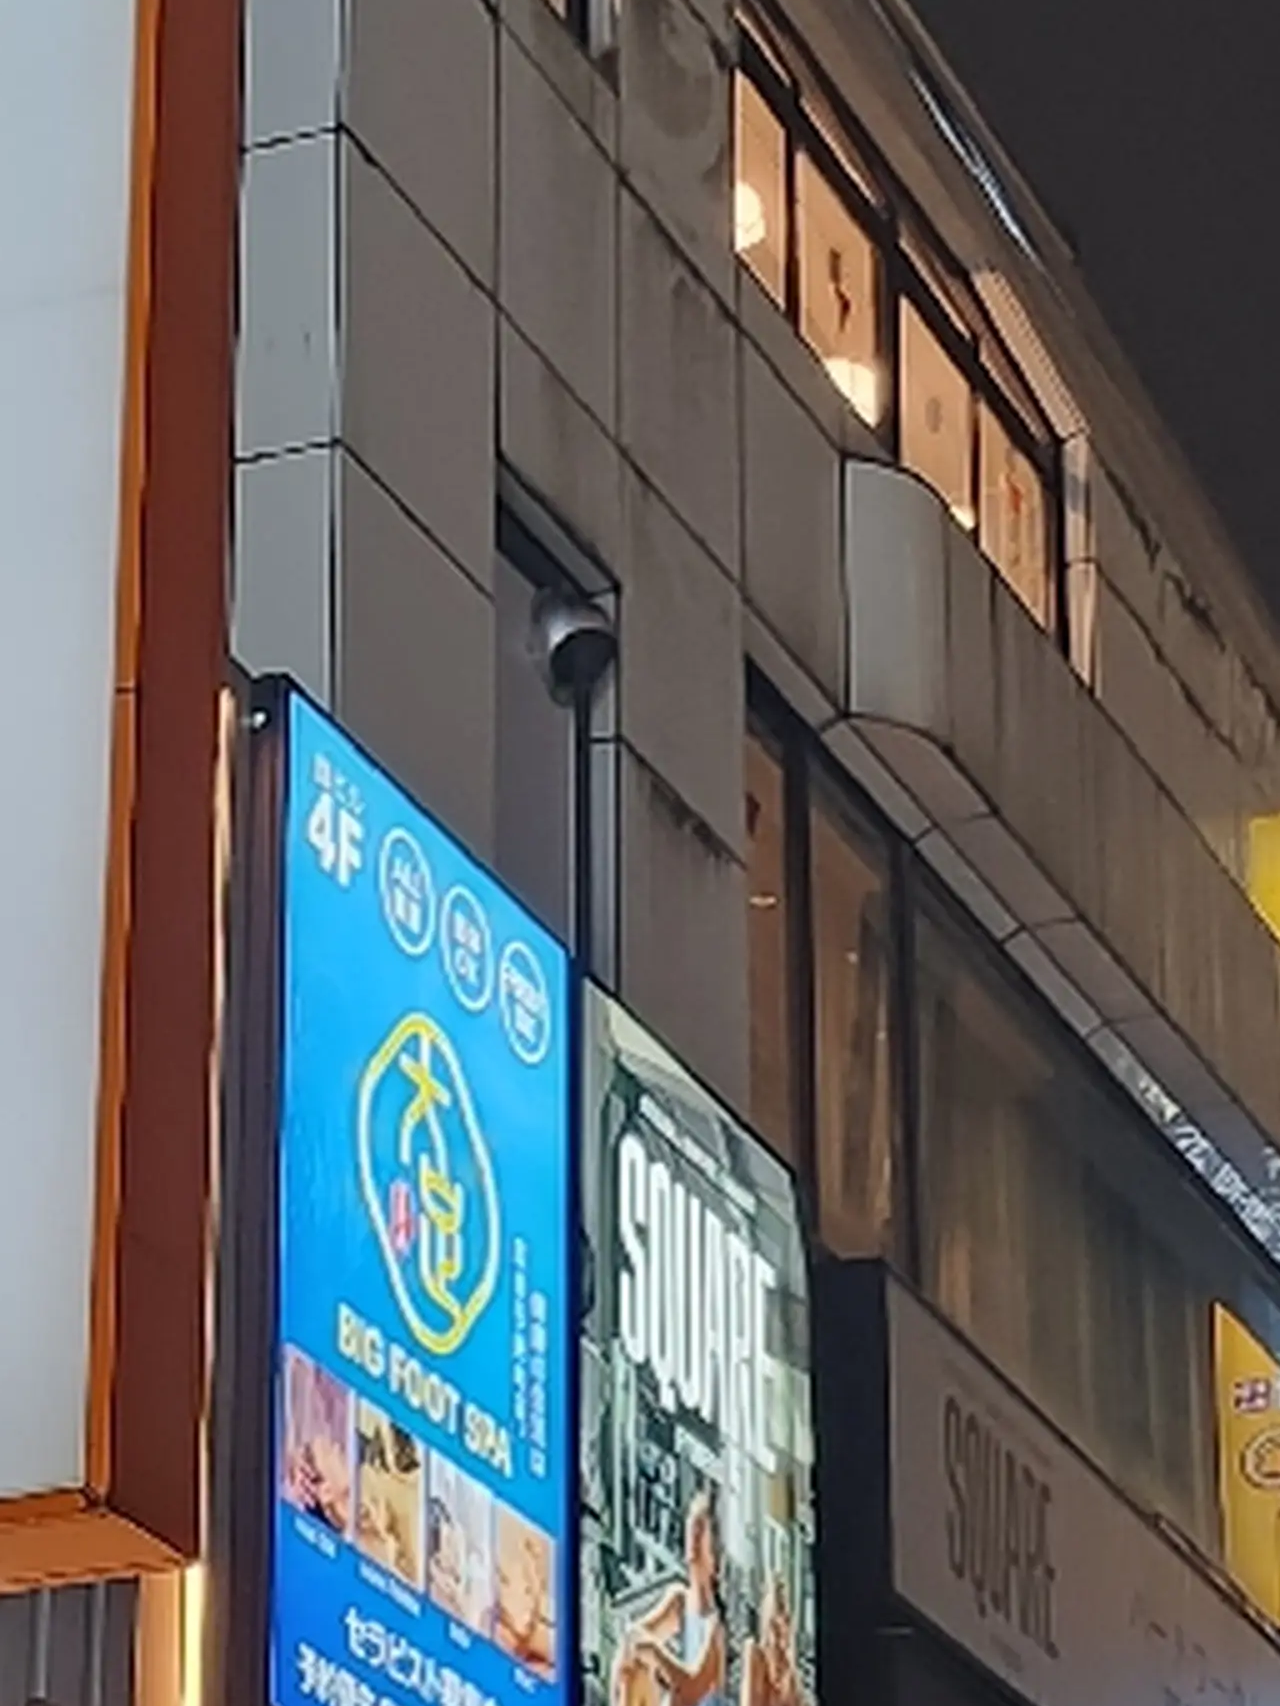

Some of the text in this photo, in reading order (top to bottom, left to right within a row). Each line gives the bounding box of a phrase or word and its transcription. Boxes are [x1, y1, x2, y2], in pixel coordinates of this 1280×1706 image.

[306, 795, 367, 887] 4F
[338, 1303, 386, 1381] BIG
[389, 1341, 461, 1430] FOOT
[464, 1396, 515, 1478] SPA
[620, 1131, 778, 1475] SQUARE
